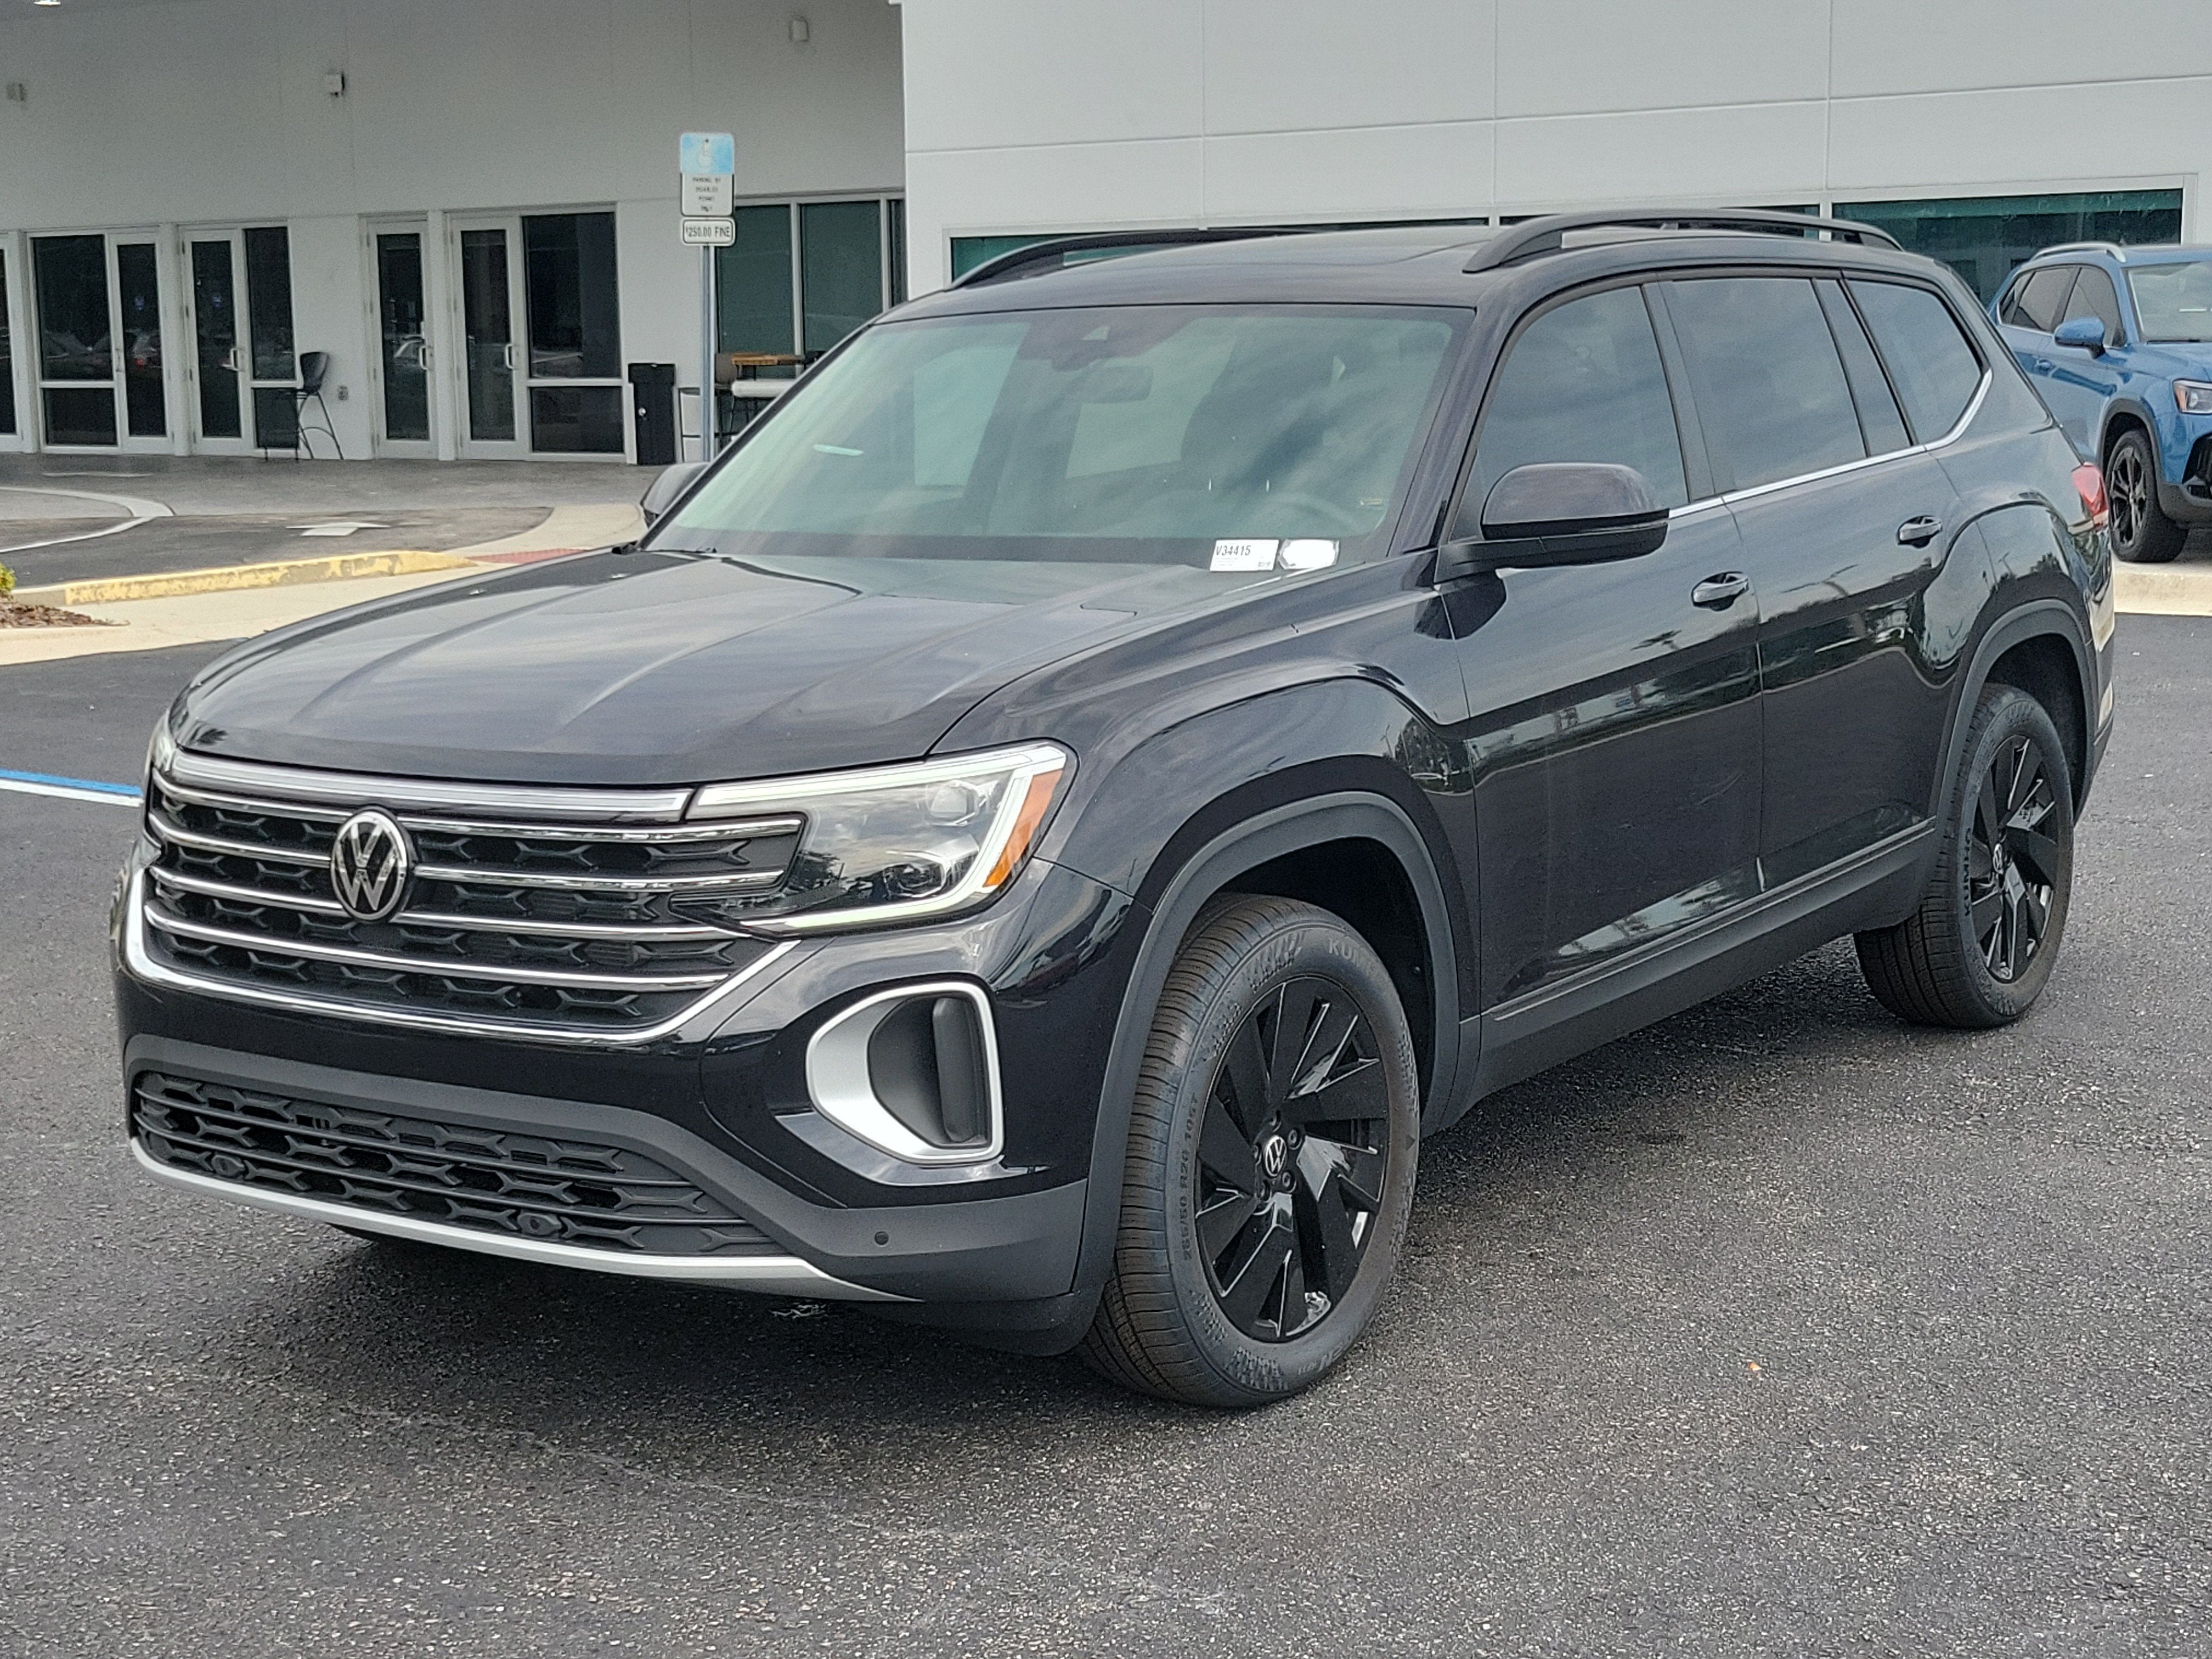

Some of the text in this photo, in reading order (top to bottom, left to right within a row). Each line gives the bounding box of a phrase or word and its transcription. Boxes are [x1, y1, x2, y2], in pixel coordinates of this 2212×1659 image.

[714, 226, 730, 238] FINE
[1216, 545, 1251, 556] V34415
[334, 820, 399, 913] VW
[1267, 1139, 1285, 1173] VW
